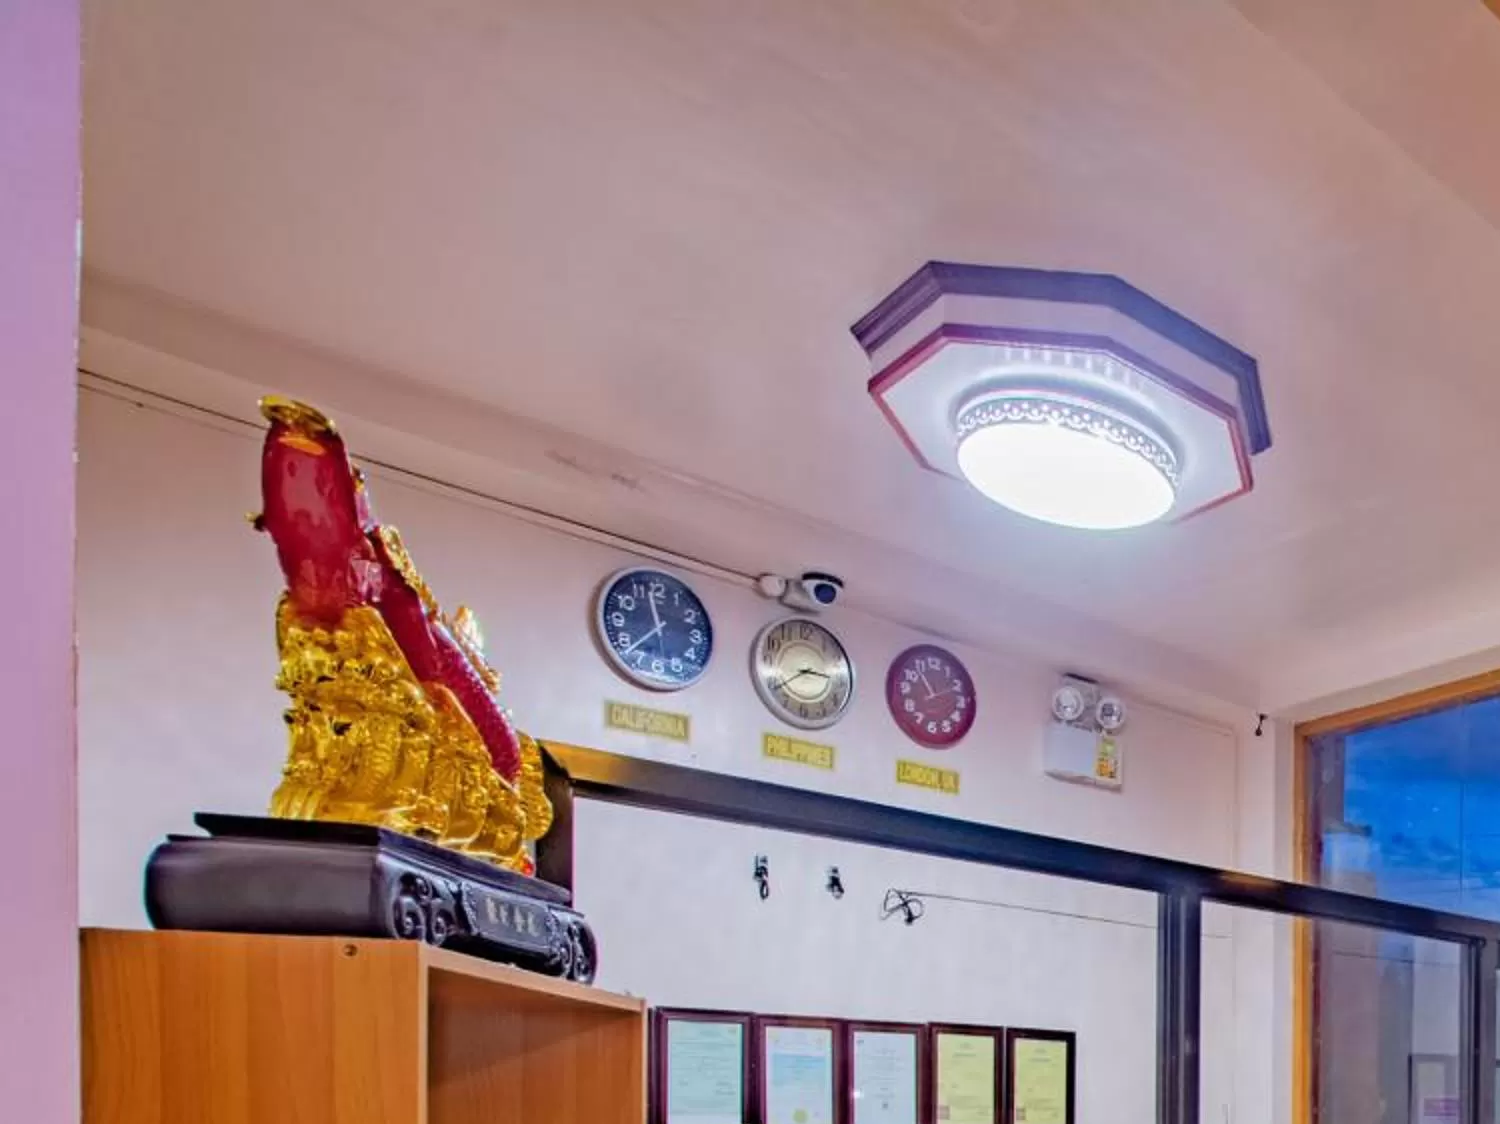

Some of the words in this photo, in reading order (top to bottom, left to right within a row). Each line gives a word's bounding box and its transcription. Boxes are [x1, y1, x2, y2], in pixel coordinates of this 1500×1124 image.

[633, 583, 645, 599] 11
[649, 582, 667, 599] 12
[617, 595, 636, 611] 10
[673, 592, 680, 607] 1
[611, 611, 625, 628] 9
[684, 609, 697, 625] 2
[618, 632, 631, 648] 8
[689, 629, 703, 645] 3
[631, 650, 646, 666] 7
[684, 647, 696, 660] 4
[651, 660, 665, 673] 6
[671, 657, 684, 673] 5
[927, 657, 941, 671] 12
[904, 668, 919, 682] 10
[943, 666, 951, 680] 1
[952, 679, 963, 693] 2
[913, 711, 925, 724] 7
[927, 721, 937, 734] 6
